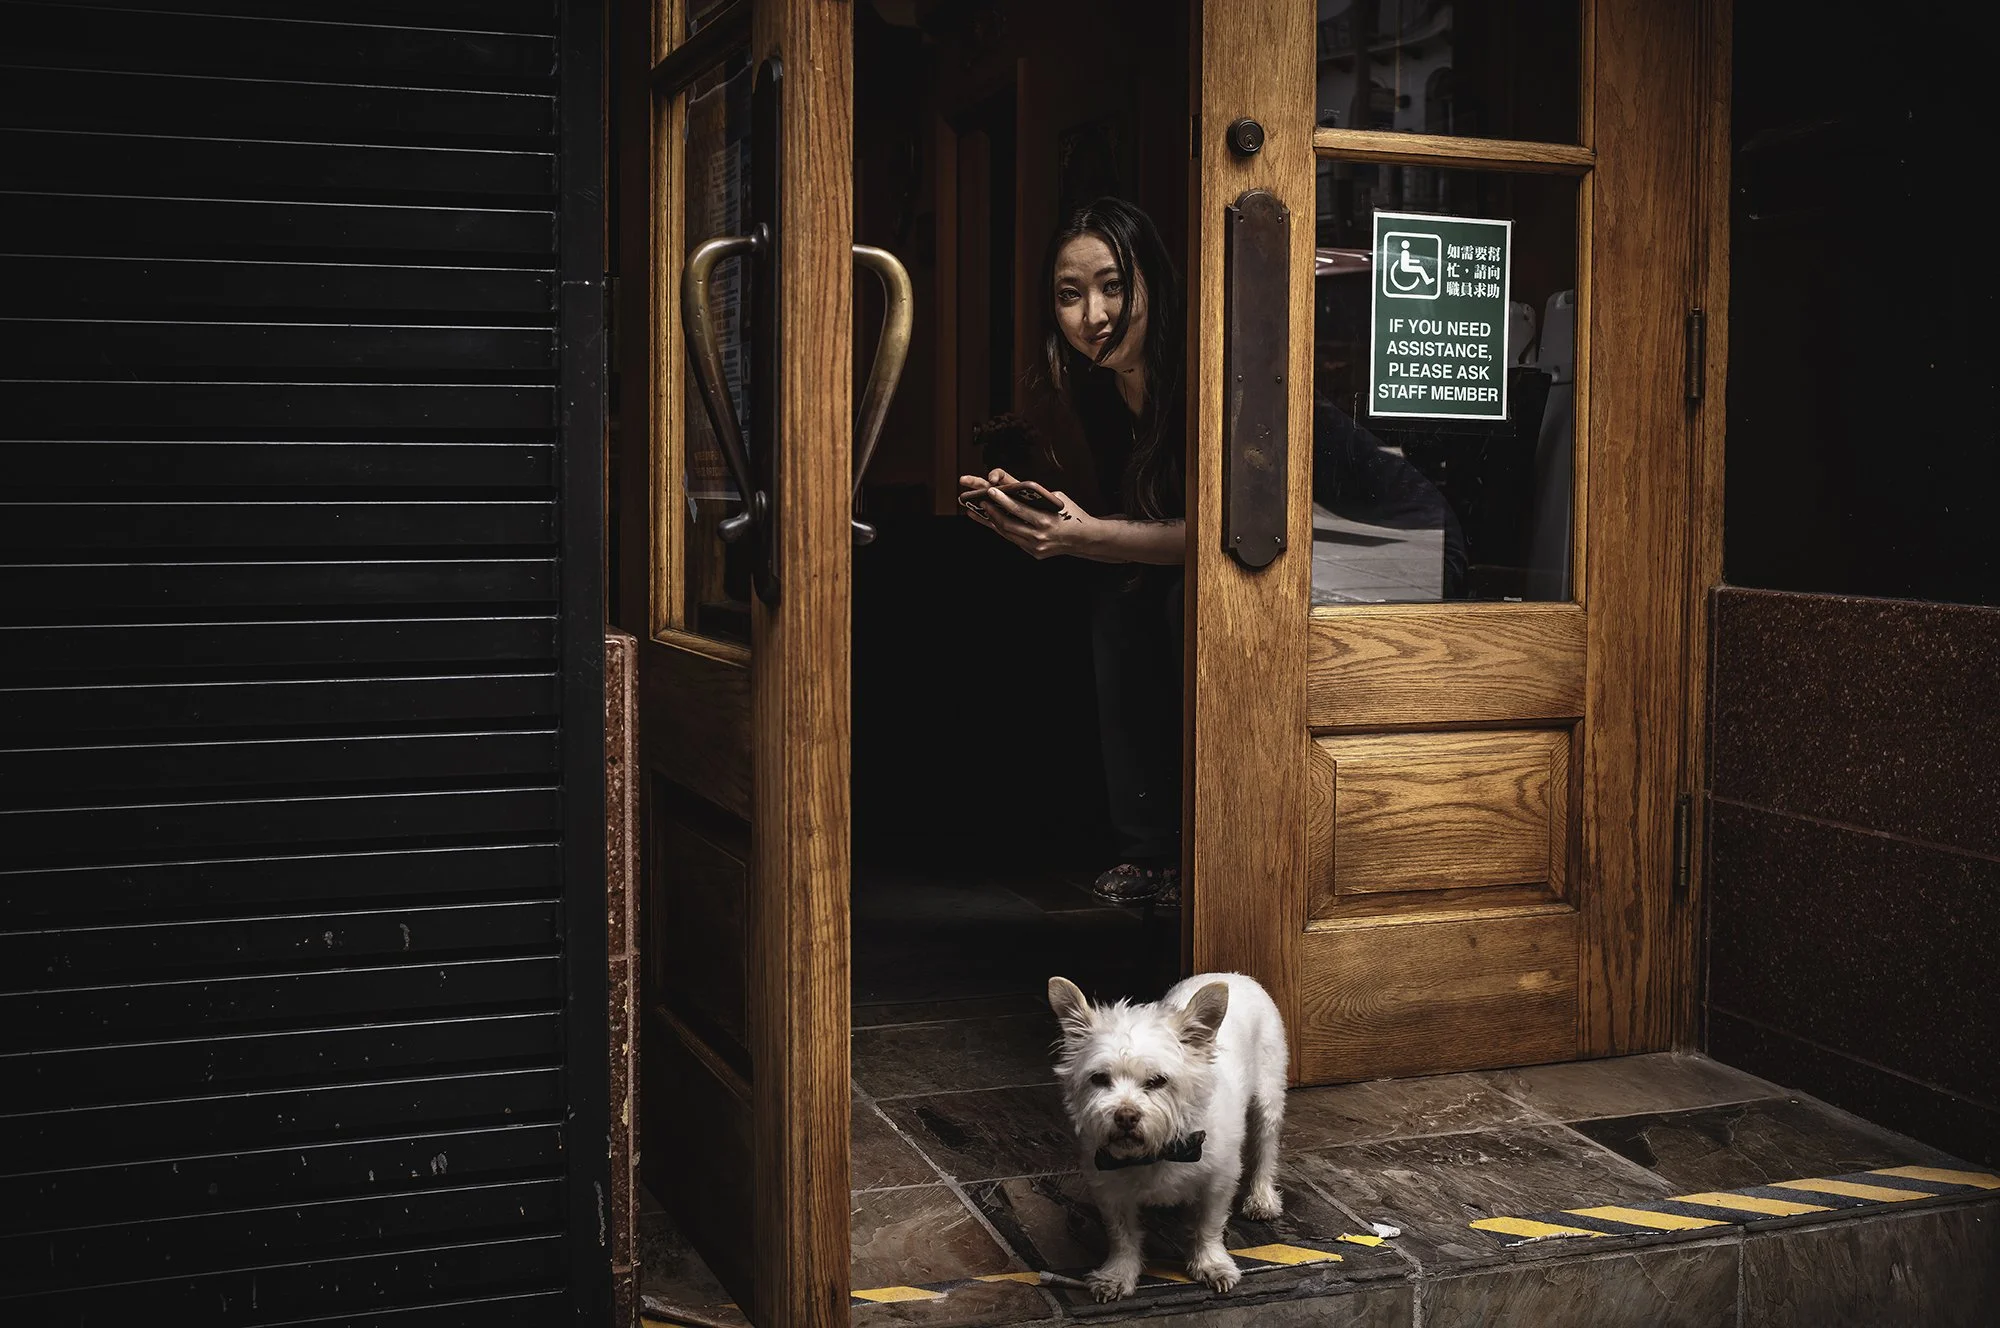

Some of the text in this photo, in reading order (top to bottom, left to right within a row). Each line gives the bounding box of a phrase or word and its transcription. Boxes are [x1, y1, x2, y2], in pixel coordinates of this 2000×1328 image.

[1447, 244, 1501, 262] 如需要幫
[1447, 281, 1500, 298] 職員求助
[1390, 319, 1491, 337] IF YOU NEED
[1387, 341, 1493, 361] ASSISTANCE,
[1389, 362, 1490, 381] PLEASE ASK
[1378, 384, 1498, 401] STAFF MEMBER
